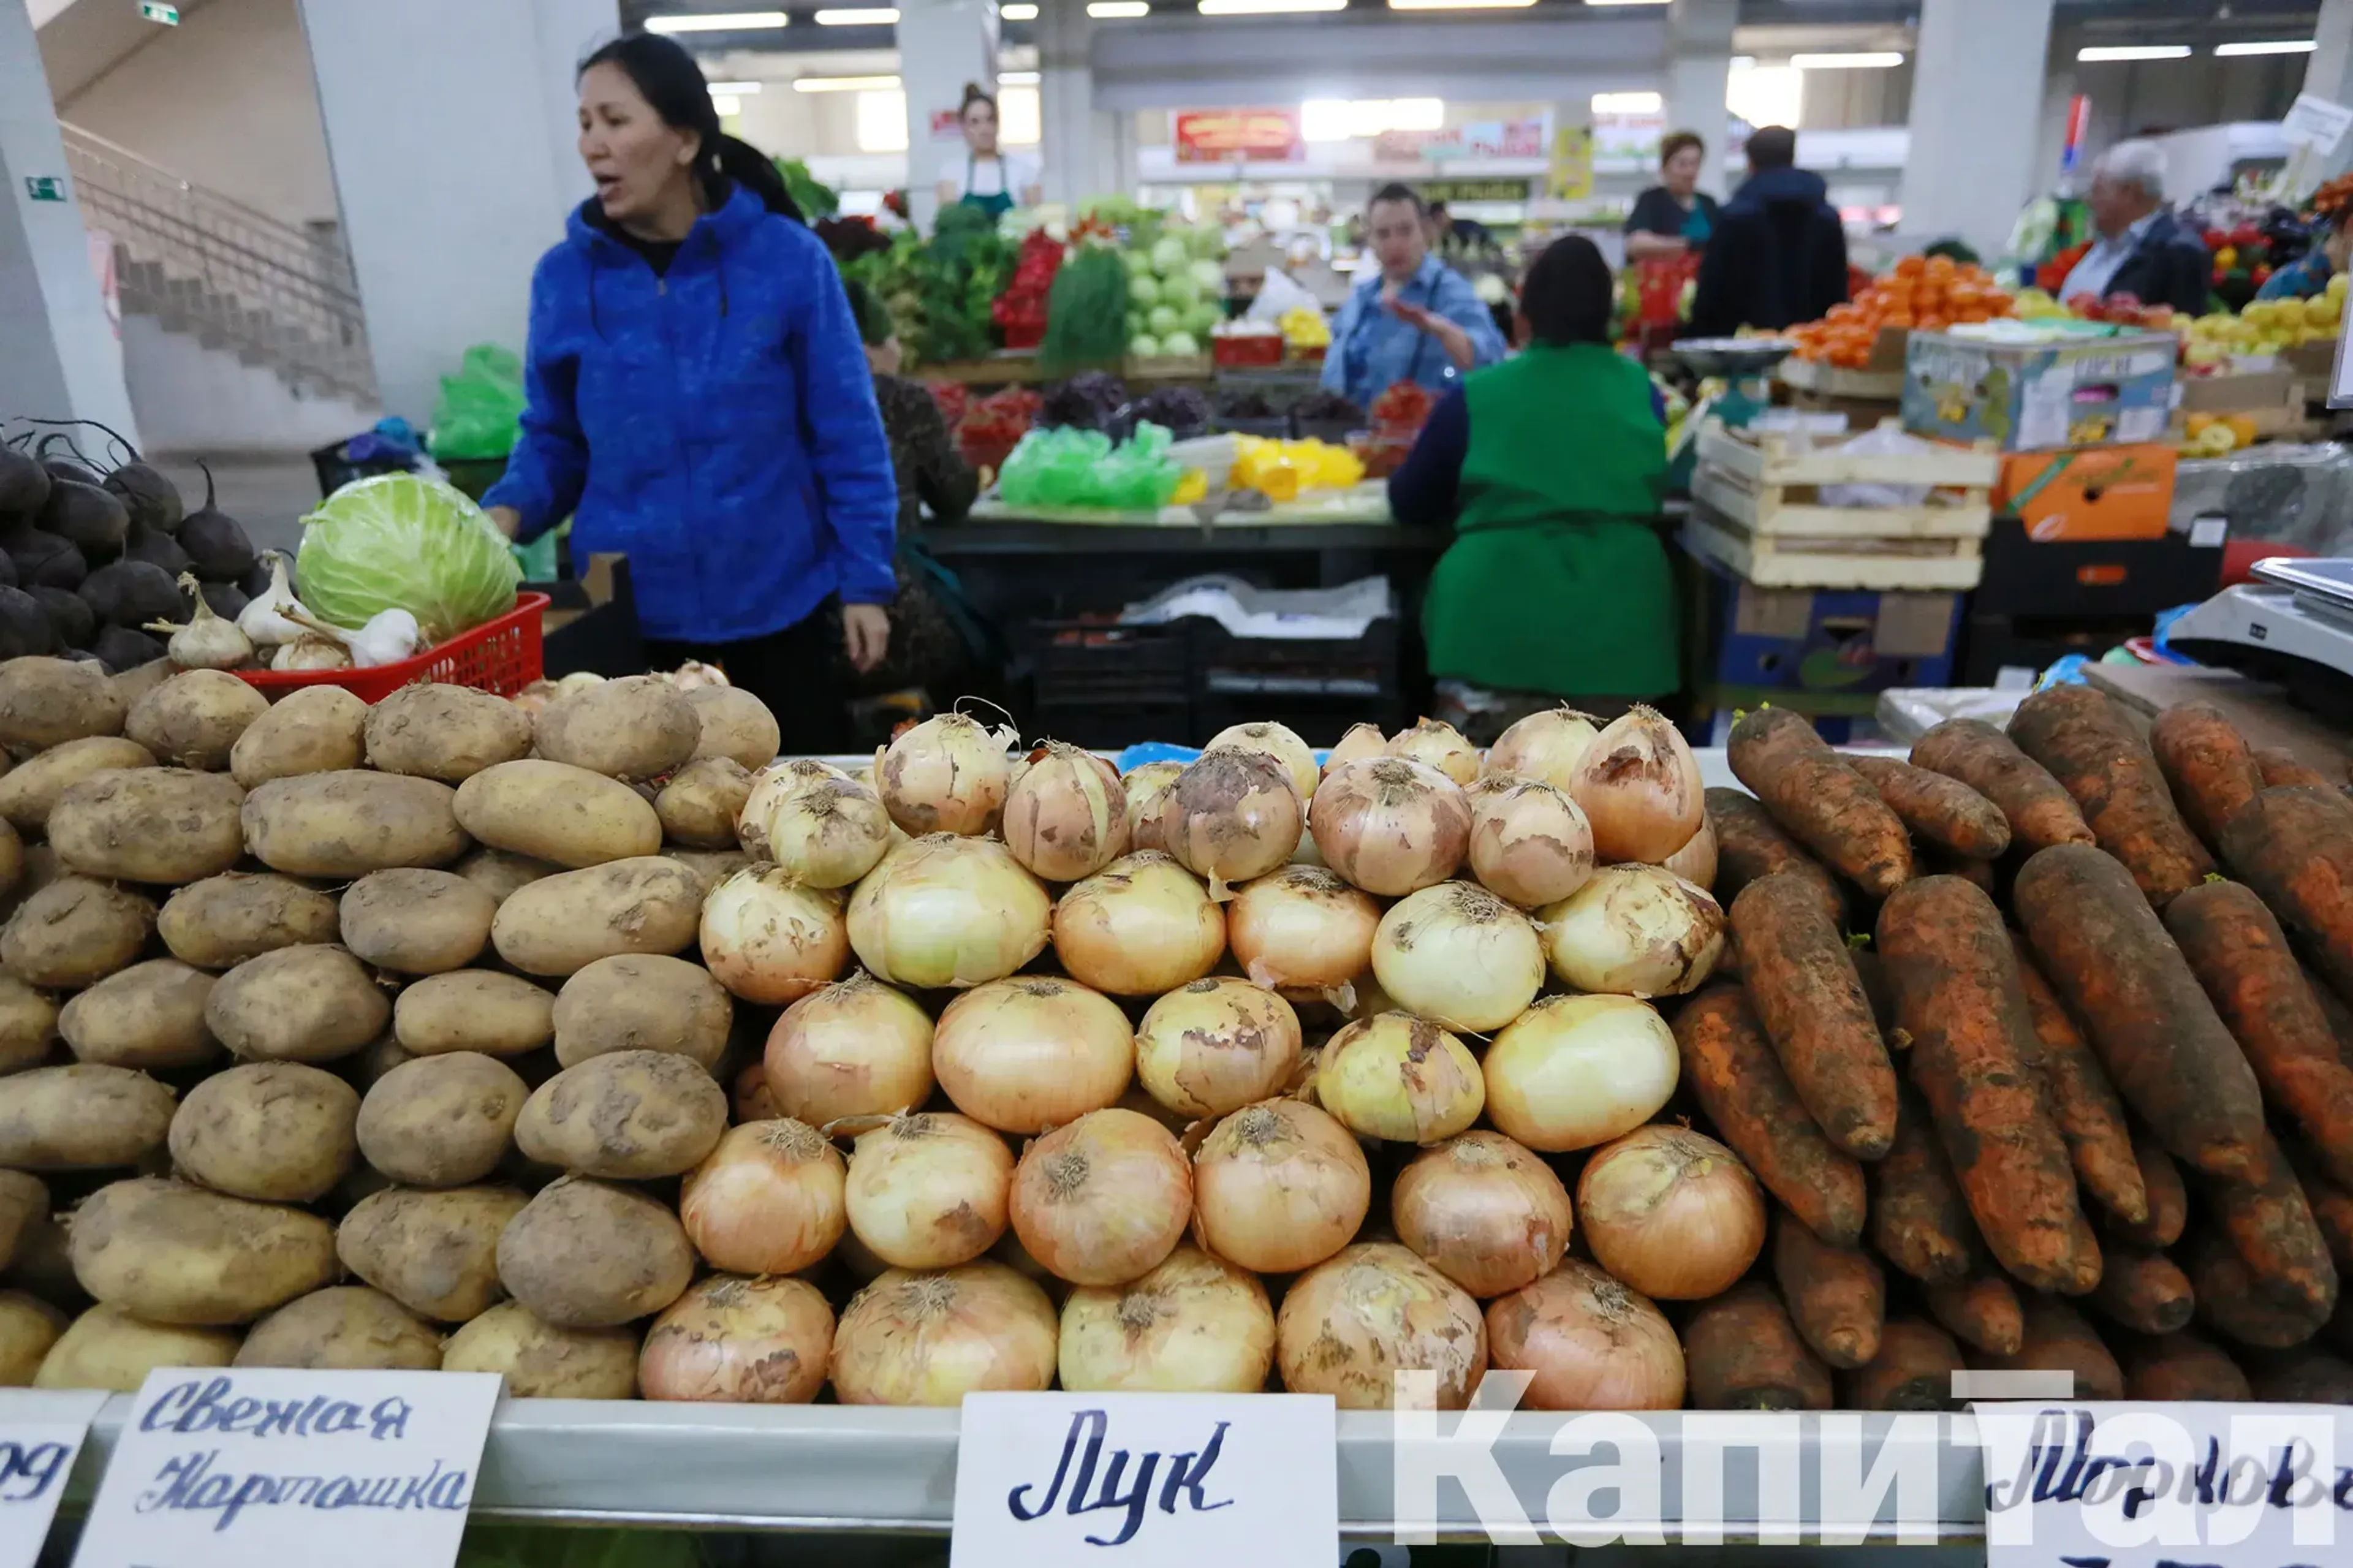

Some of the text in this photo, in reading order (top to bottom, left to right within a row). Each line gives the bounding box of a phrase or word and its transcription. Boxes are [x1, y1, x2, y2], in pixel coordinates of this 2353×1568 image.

[139, 1376, 413, 1440] Свежая
[135, 1449, 469, 1532] Картошка
[1008, 1409, 1235, 1547] Лук
